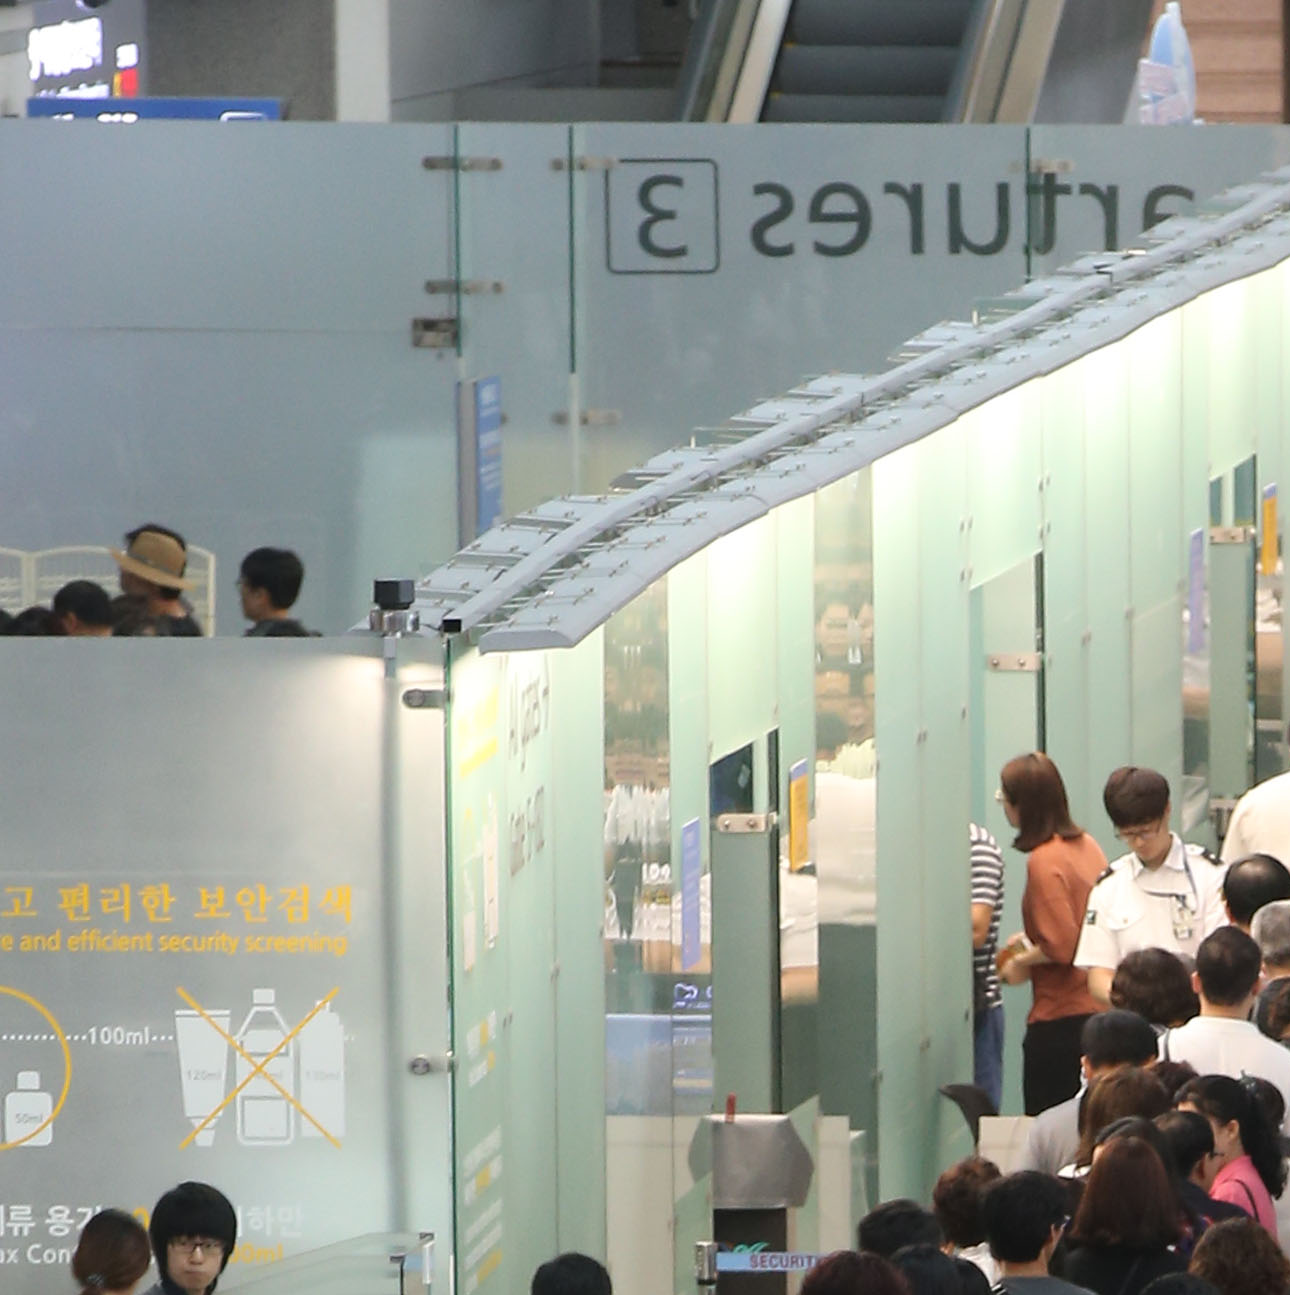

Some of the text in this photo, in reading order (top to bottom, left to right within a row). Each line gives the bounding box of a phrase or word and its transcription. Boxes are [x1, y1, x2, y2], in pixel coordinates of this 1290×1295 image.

[57, 882, 175, 923] 편리한
[193, 882, 353, 924] 보안검색
[19, 929, 61, 952] and
[66, 928, 153, 952] efficient
[158, 931, 240, 955] security
[245, 931, 348, 956] screening
[87, 1026, 150, 1046] 100ml
[186, 1069, 223, 1081] 120ml
[14, 1112, 44, 1125] 50ml
